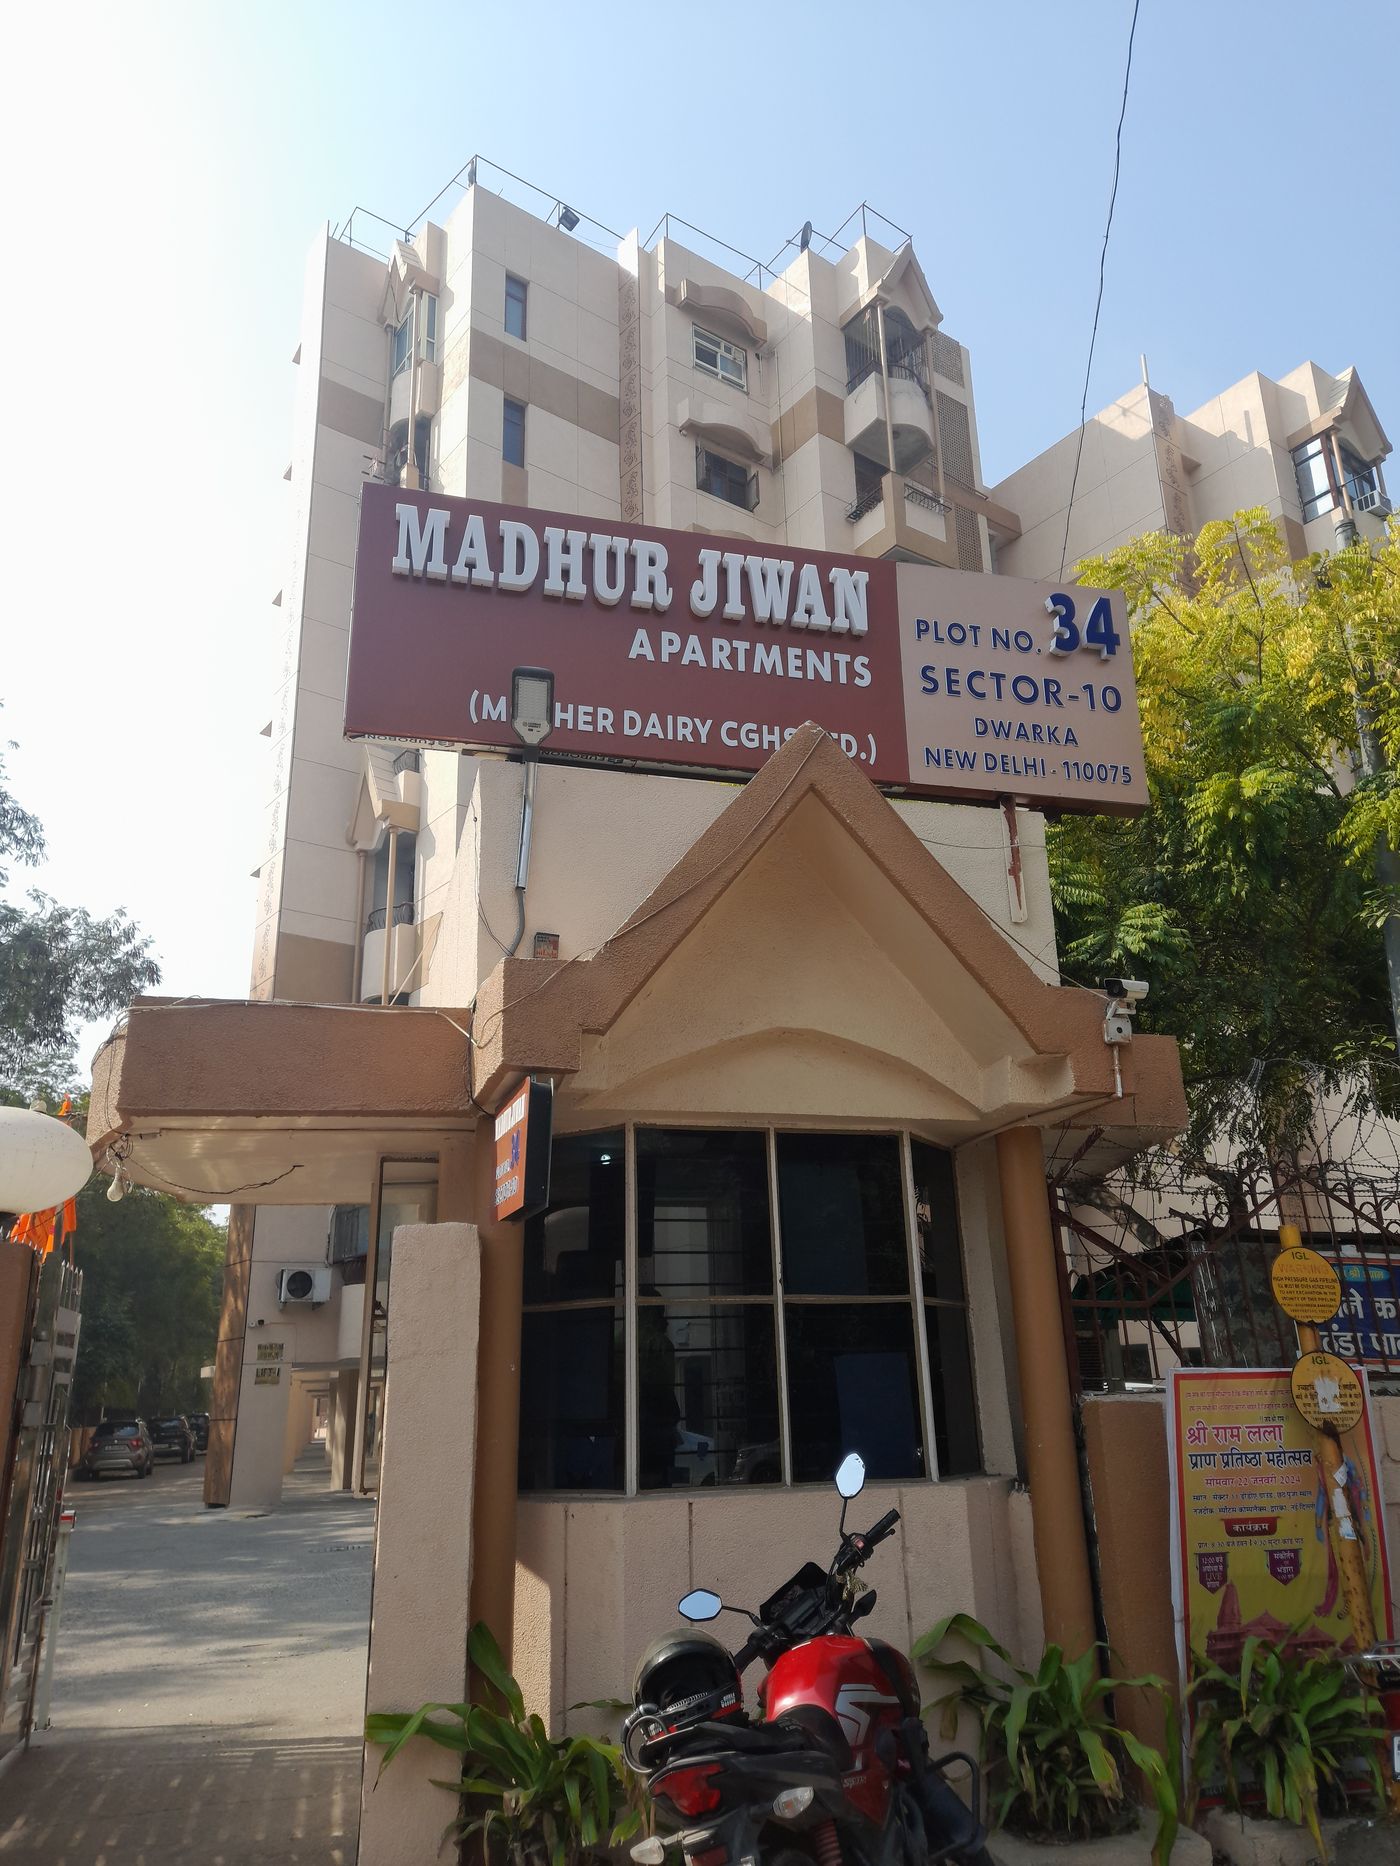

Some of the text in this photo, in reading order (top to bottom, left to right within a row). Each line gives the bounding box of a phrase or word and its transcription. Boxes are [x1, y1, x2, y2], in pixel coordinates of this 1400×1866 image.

[391, 503, 870, 637] MADHUR JIWAN
[915, 592, 1121, 661] PLOT NO. 34
[628, 629, 872, 688] APARTMENTS
[920, 664, 1122, 713] SECTOR-10
[470, 689, 615, 734] (MHER
[623, 710, 713, 746] DAIRY
[974, 717, 1079, 747] DWARKA
[924, 746, 977, 770] NEW
[984, 752, 1047, 777] DELHI
[1062, 760, 1132, 784] 110075
[1291, 1251, 1311, 1261] IGL
[1311, 1356, 1330, 1365] IGL
[1187, 1420, 1284, 1444] श्री राम लला
[1189, 1445, 1312, 1469] प्राण प्रतिष्ठा महोत्सव
[1232, 1521, 1269, 1532] कार्यक्रम
